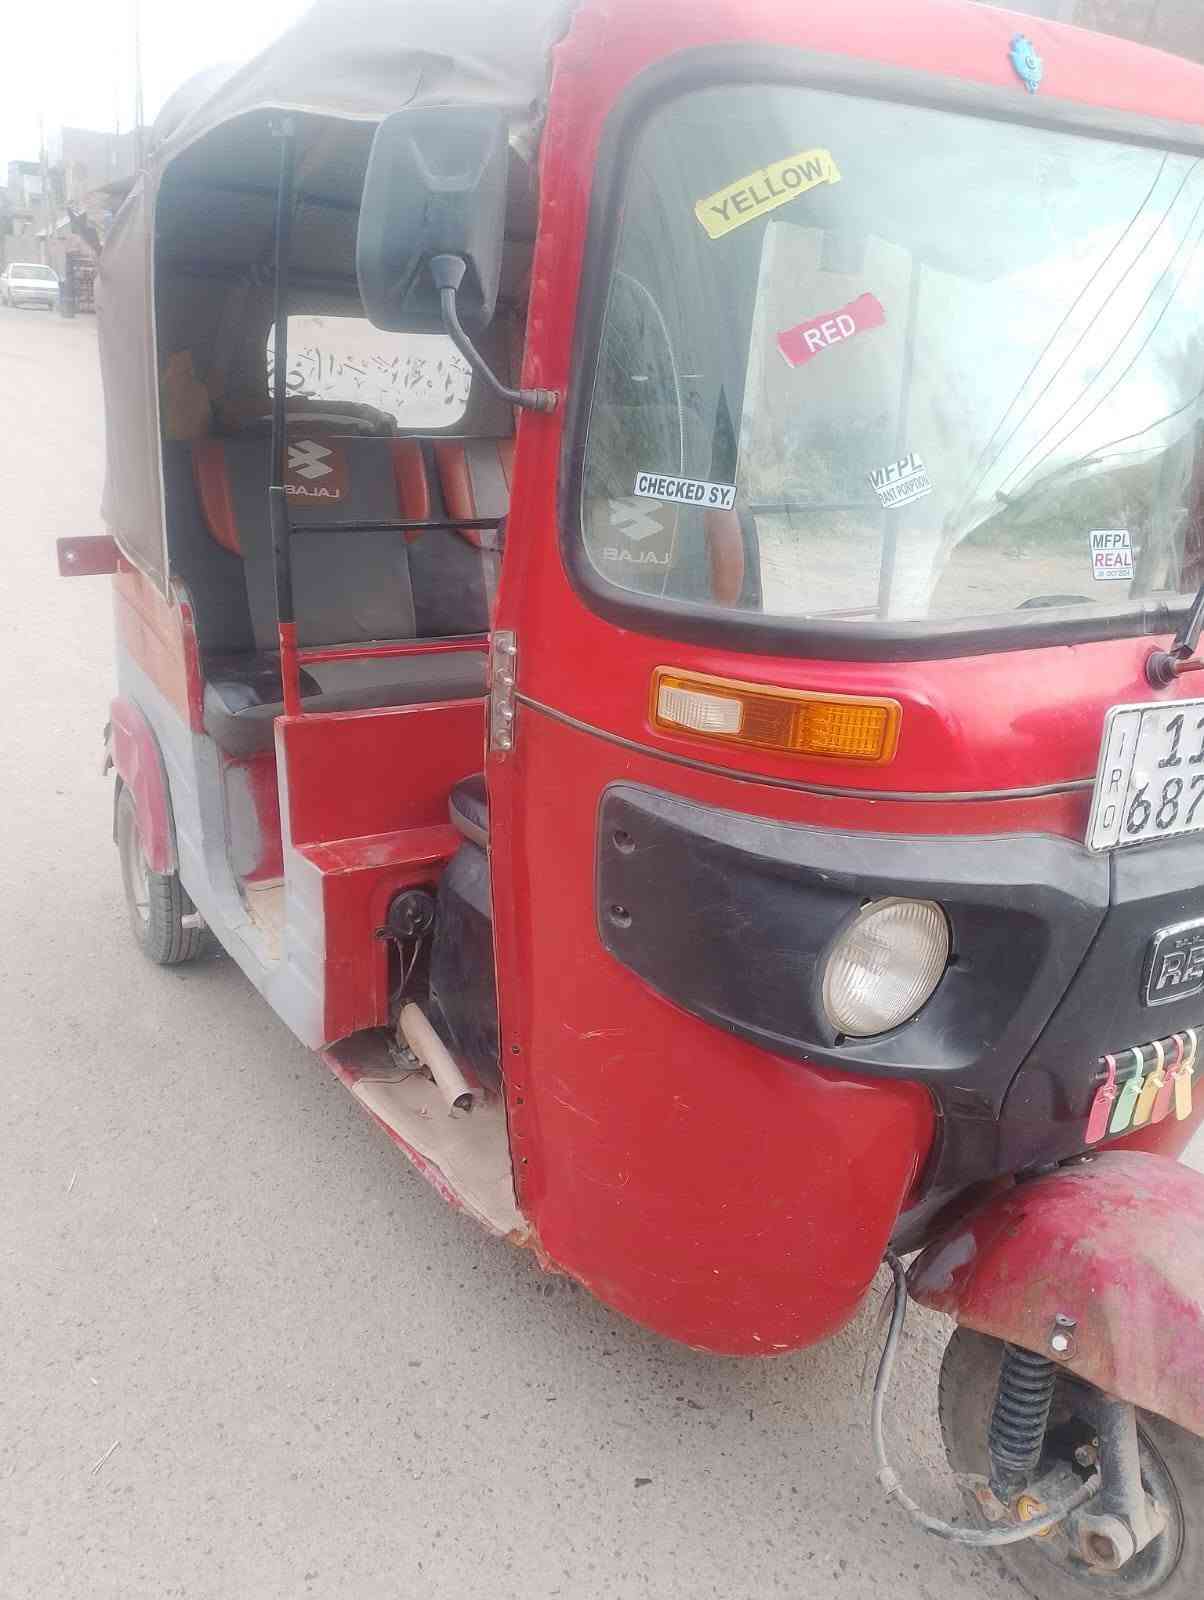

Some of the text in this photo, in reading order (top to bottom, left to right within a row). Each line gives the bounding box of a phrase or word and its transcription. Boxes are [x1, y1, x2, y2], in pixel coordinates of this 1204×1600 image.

[711, 157, 823, 221] YELLOW
[803, 313, 856, 353] RED
[639, 475, 731, 506] CHECKED SY.
[1092, 533, 1130, 549] MFPL
[1094, 552, 1132, 567] REAL
